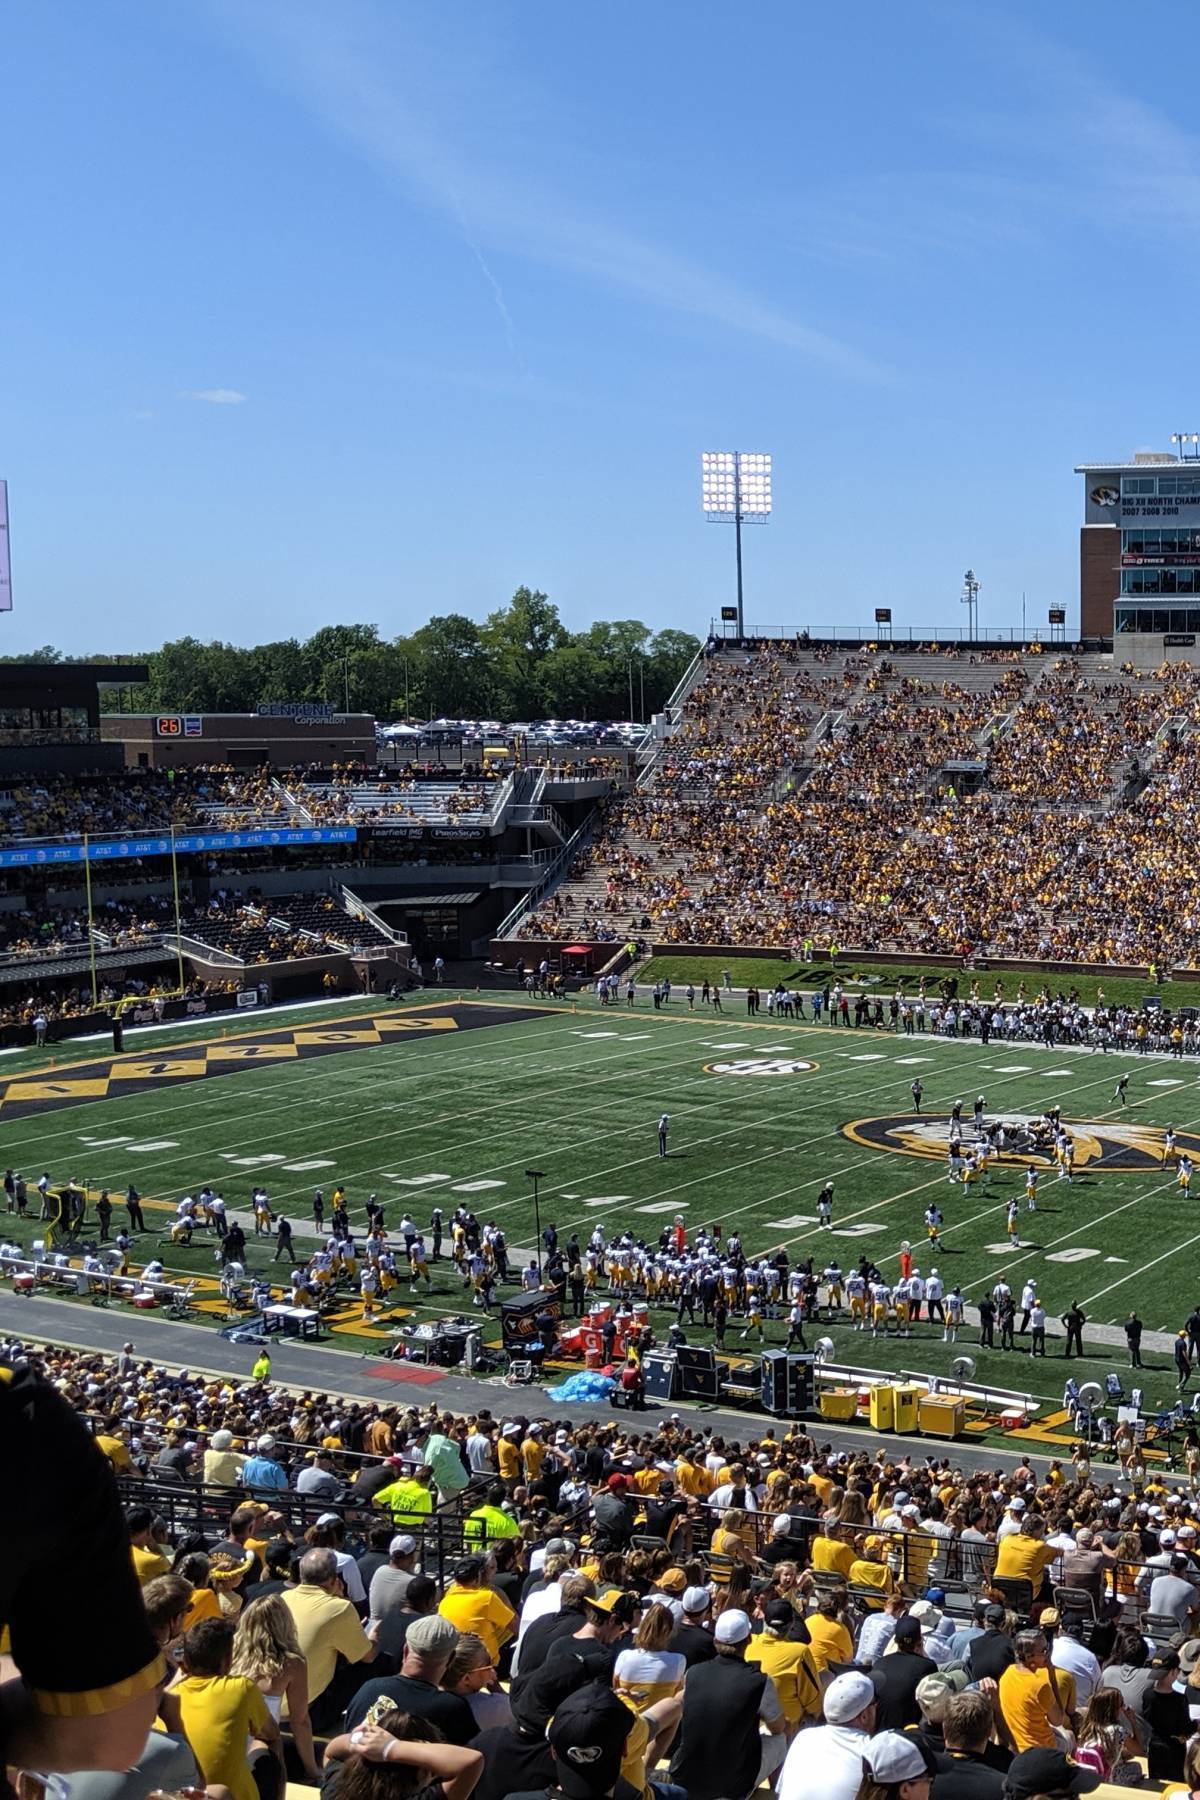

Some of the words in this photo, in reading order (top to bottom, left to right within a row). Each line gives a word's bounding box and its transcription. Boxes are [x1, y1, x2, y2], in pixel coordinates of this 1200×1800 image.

[1148, 497, 1173, 506] NORTH
[1122, 507, 1140, 516] 2007
[1162, 507, 1179, 516] 2010
[257, 703, 334, 716] CENTENE
[160, 719, 178, 733] 26
[294, 715, 346, 727] Corporation
[287, 833, 304, 841] AT&T
[330, 831, 348, 839] AT&T
[318, 1253, 332, 1265] 72
[584, 1333, 597, 1348] G
[1006, 1418, 1013, 1427] G
